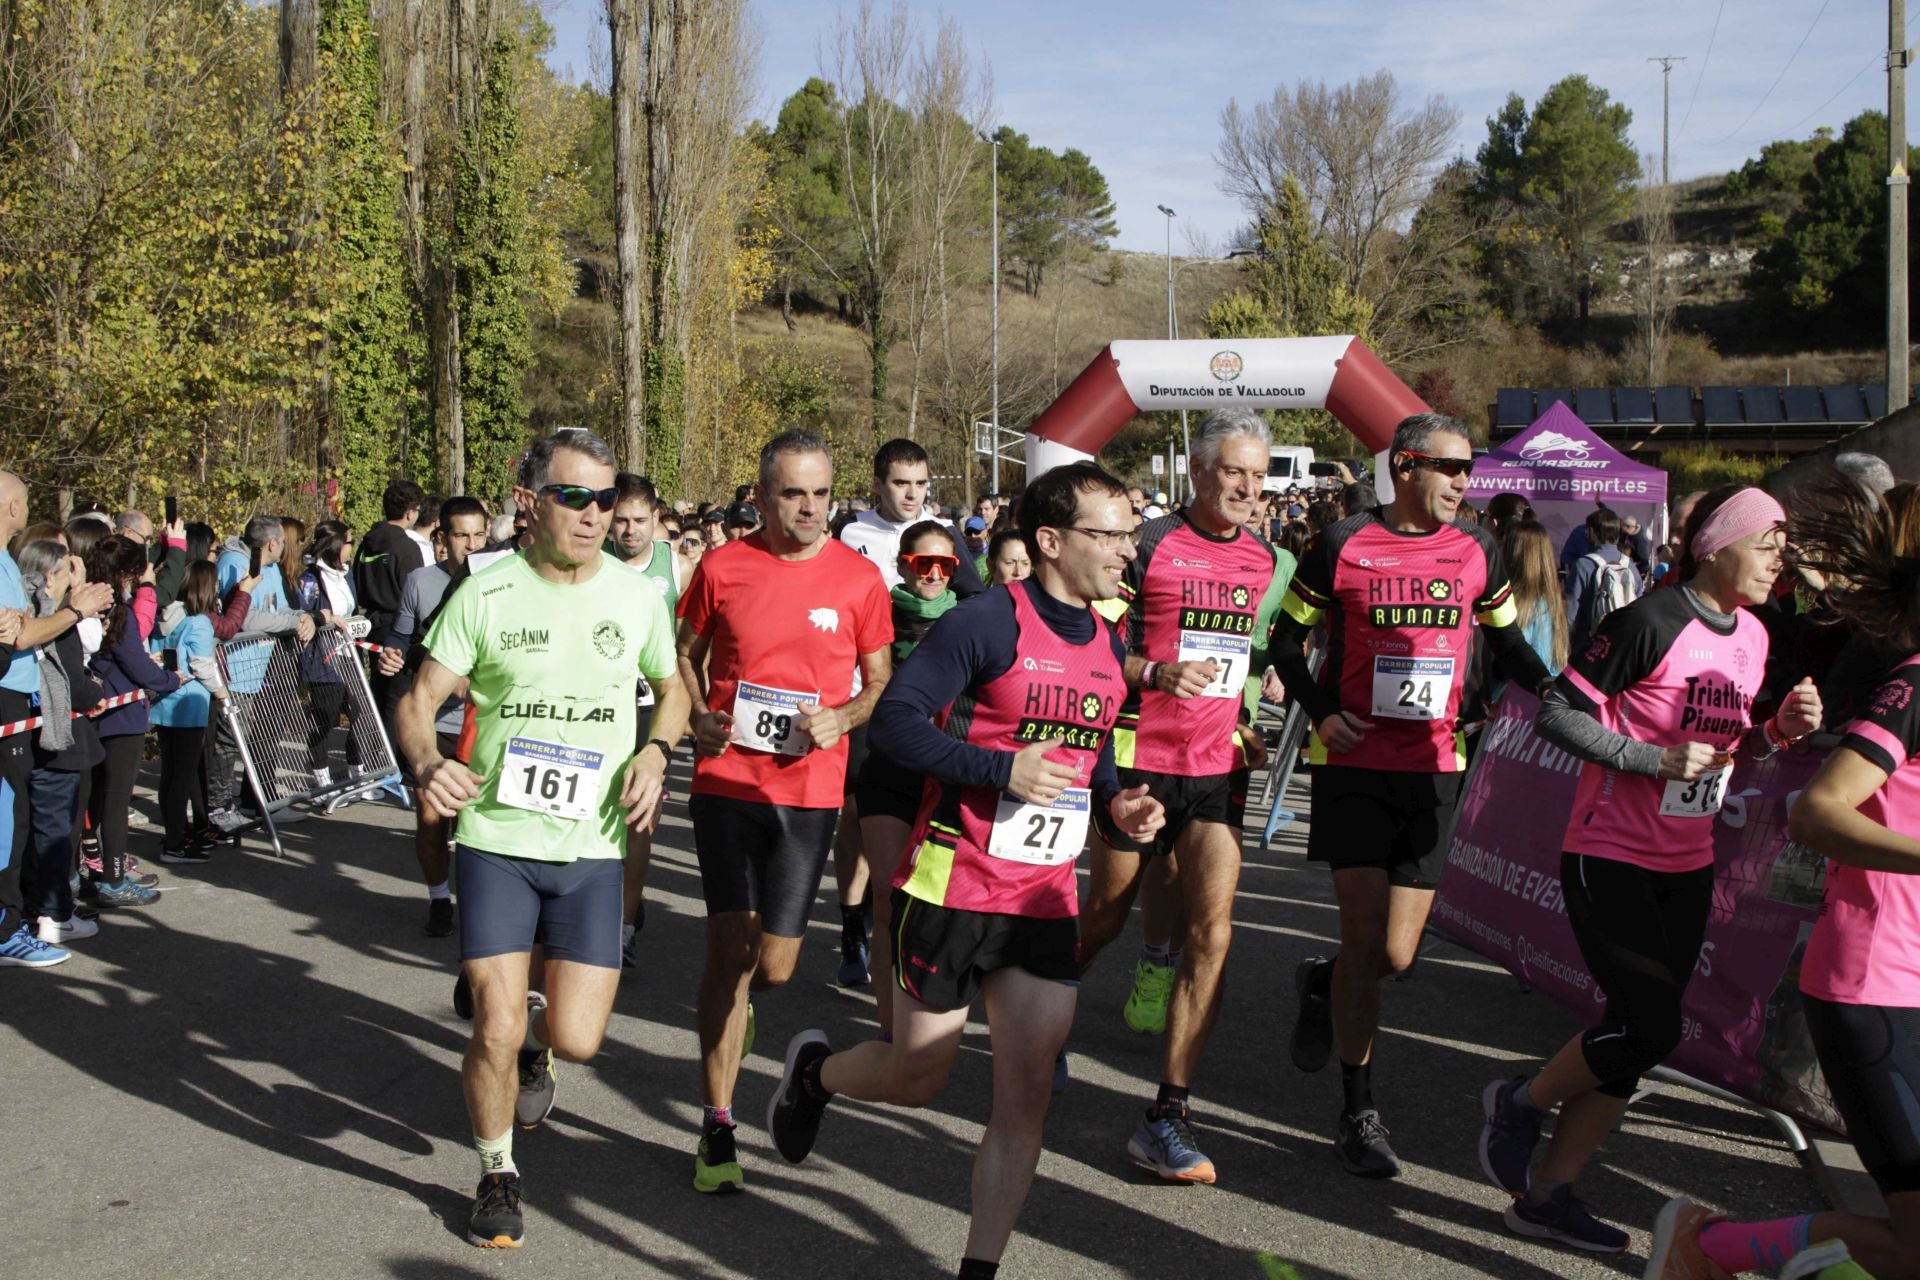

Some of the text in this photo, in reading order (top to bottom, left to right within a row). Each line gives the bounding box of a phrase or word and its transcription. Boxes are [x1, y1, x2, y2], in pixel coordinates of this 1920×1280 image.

[1149, 384, 1306, 397] DIPUTACIÓN DE VALLADOLID
[1502, 460, 1611, 469] RUNVASPORT
[1467, 476, 1647, 496] www.runvasport.es
[1185, 611, 1252, 632] RUNNER
[1375, 607, 1459, 626] RUNNER
[1379, 661, 1451, 670] CARRERA POPULAR
[741, 686, 777, 701] CARRERA
[1398, 681, 1433, 708] 24
[500, 700, 616, 722] CUÉLLAR
[755, 711, 791, 741] 89
[511, 740, 600, 763] CARRERA POPULAR
[523, 764, 579, 803] 161
[1055, 794, 1087, 804] OPULAR
[1023, 813, 1064, 849] 27
[1504, 862, 1526, 896] DE
[1526, 943, 1592, 990] Clasificaciones
